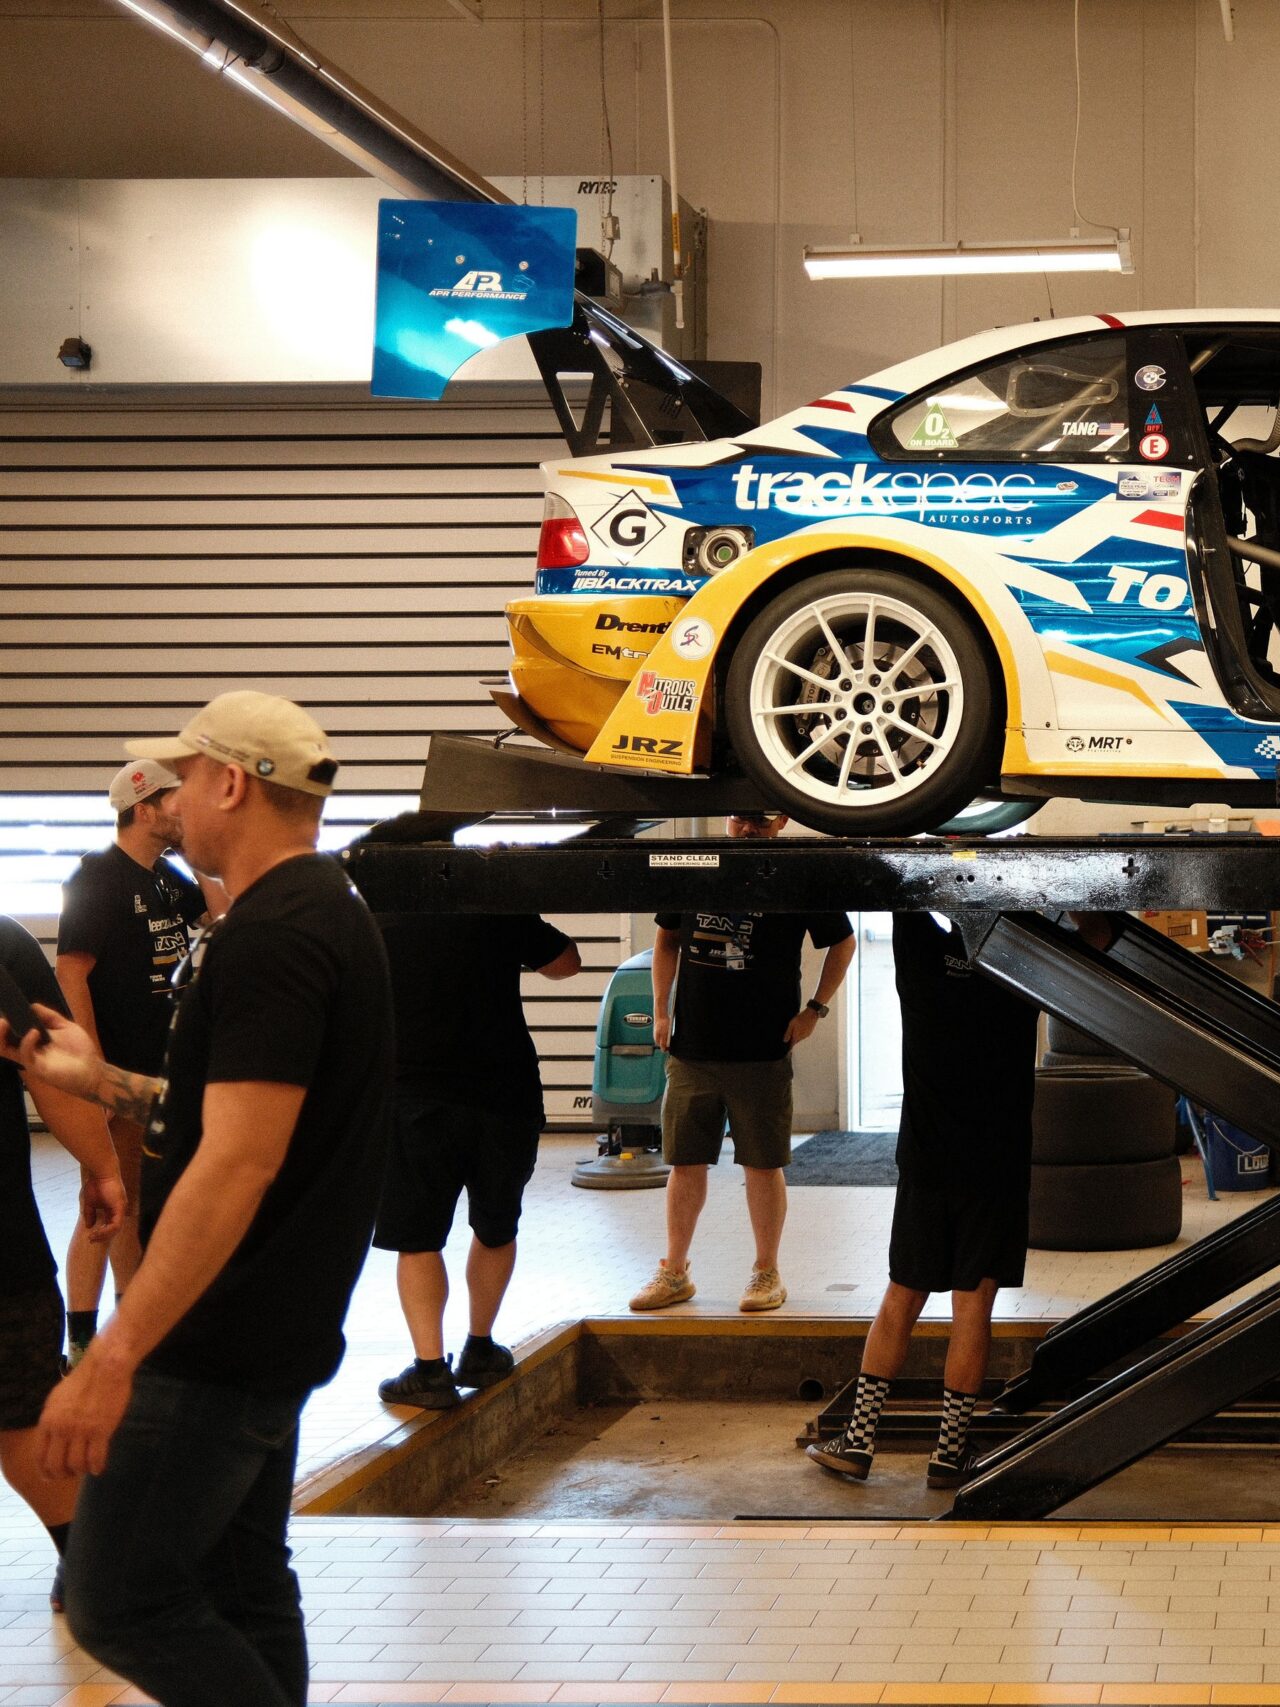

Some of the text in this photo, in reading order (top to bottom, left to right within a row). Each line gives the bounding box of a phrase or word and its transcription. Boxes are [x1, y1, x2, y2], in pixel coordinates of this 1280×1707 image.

[577, 181, 618, 194] RYTEC
[451, 291, 527, 300] PERFORMANCE
[924, 439, 955, 447] BOARD
[1149, 438, 1159, 454] E
[731, 463, 1036, 523] trackspec
[609, 508, 648, 547] G
[928, 514, 1033, 525] AUTOSPORTS
[574, 569, 598, 577] Tuned
[1107, 565, 1188, 611] TO
[595, 613, 673, 635] Drent
[592, 643, 650, 660] EMtr
[637, 671, 695, 697] NITROUS
[647, 689, 699, 714] OUTLET
[612, 735, 683, 756] JRZ
[1088, 736, 1124, 749] MRT
